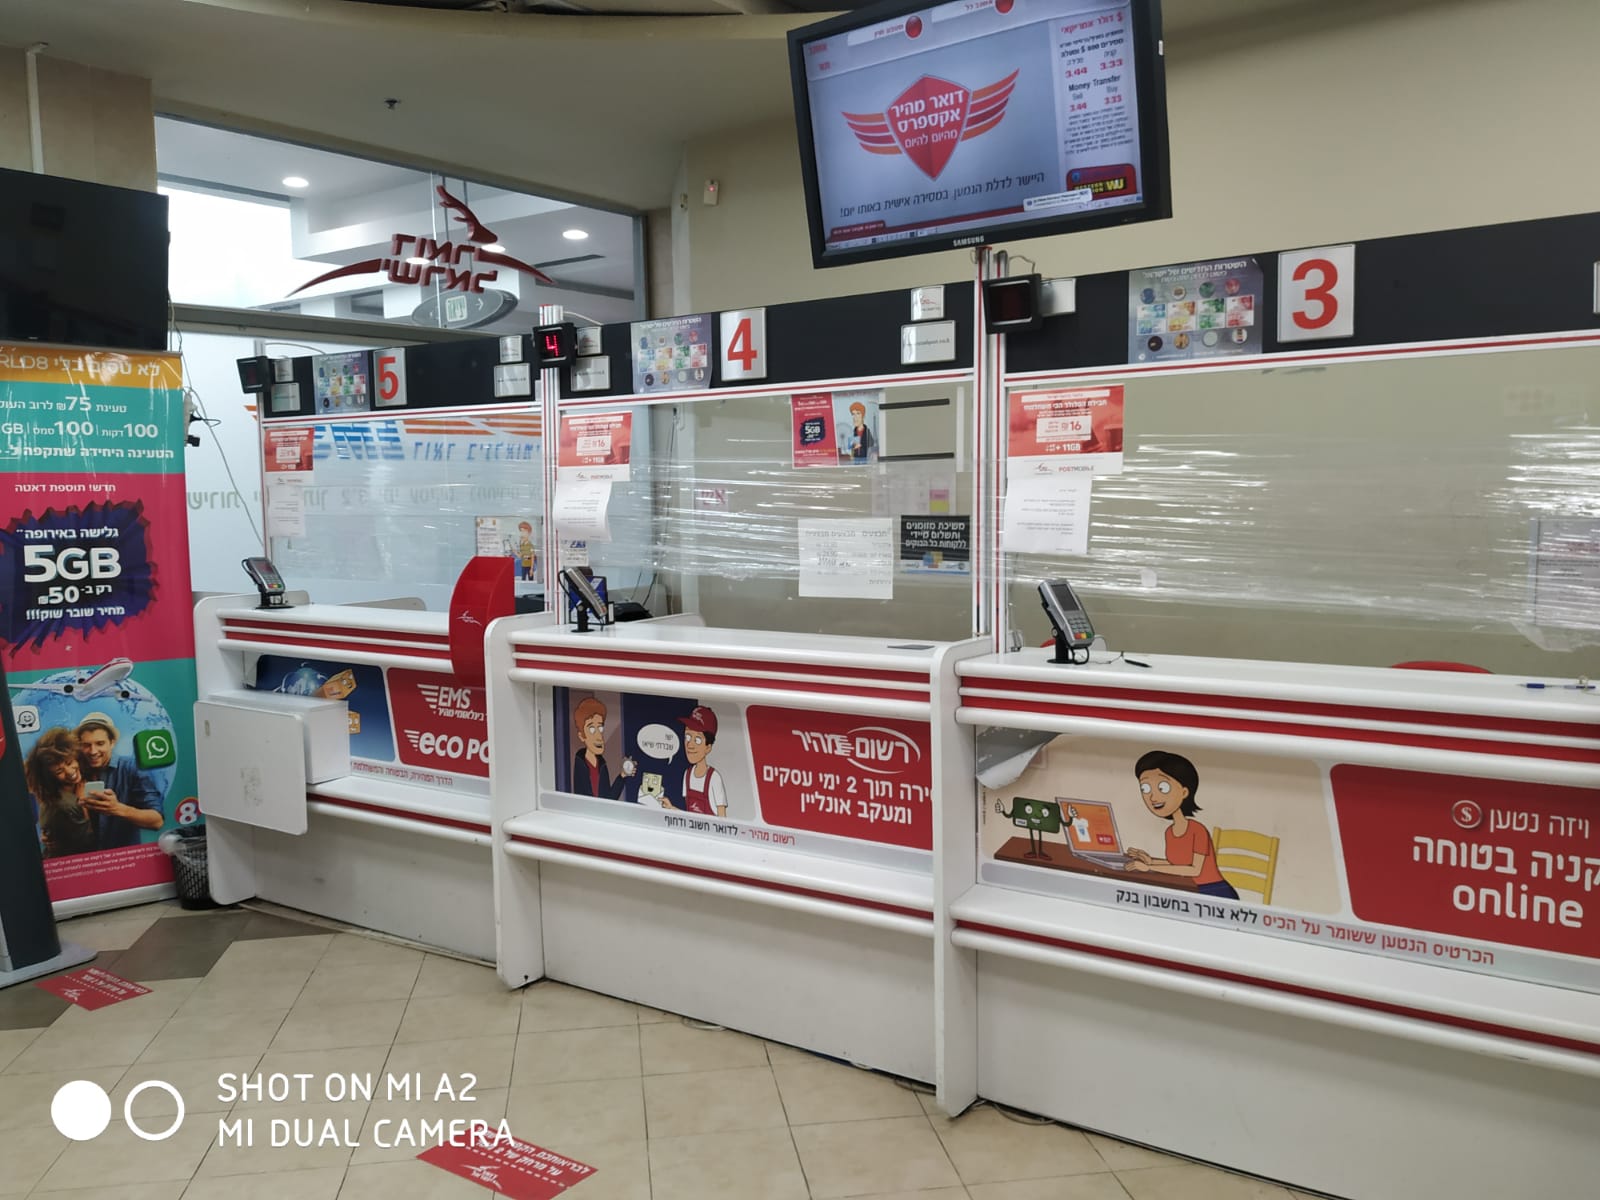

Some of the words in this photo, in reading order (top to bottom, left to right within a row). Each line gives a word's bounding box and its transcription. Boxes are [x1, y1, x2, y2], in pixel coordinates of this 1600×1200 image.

[1068, 82, 1091, 92] Money
[1092, 74, 1121, 87] Transfer
[929, 89, 964, 109] דואר
[891, 99, 926, 118] מהיר
[897, 108, 961, 133] אקספרס
[904, 134, 929, 148] להיום
[931, 129, 959, 143] מהיום
[985, 174, 1012, 193] לדלת
[1014, 170, 1045, 187] היישר
[1106, 179, 1124, 191] WU
[912, 188, 949, 206] במסירה
[953, 183, 983, 201] הנמען
[839, 205, 855, 218] יום!
[857, 202, 881, 216] באותו
[883, 196, 911, 210] אישית
[953, 236, 985, 247] SAMSUNG
[1292, 259, 1338, 329] 3
[546, 335, 558, 357] 4
[727, 318, 757, 370] 4
[378, 357, 399, 401] 5
[28, 400, 54, 410] לרוב
[96, 404, 127, 413] טעינת
[54, 421, 94, 436] 100
[102, 429, 123, 438] דקות
[124, 423, 158, 438] 100
[24, 446, 76, 458] שתקפה
[80, 447, 124, 458] היחידה
[128, 449, 174, 459] הטעינה
[15, 484, 46, 492] דאטה
[50, 484, 86, 492] תוספת
[89, 484, 116, 492] חדש!
[80, 526, 119, 538] גלישה
[906, 522, 937, 530] מזומנים
[938, 522, 965, 530] משיכת
[931, 531, 960, 541] ותשלום
[23, 544, 122, 583] 5GB
[96, 584, 112, 595] רק
[26, 609, 63, 621] שוק!!!
[66, 607, 94, 618] שובר
[97, 605, 125, 616] מחיר
[438, 686, 472, 710] EMS
[437, 707, 454, 718] מהיר
[791, 729, 852, 756] מהיר
[855, 737, 910, 764] רשום
[762, 765, 813, 787] עסקים
[818, 771, 840, 790] ימי
[846, 775, 857, 793] 2
[863, 778, 893, 800] תוך
[899, 782, 932, 803] ירה
[800, 790, 851, 815] אונליין
[179, 802, 198, 825] 8
[664, 815, 687, 827] ודחוף
[857, 801, 912, 825] ומעקב
[1489, 808, 1539, 833] נטען
[688, 819, 710, 832] חשוב
[712, 823, 738, 836] לדואר
[1549, 815, 1590, 839] ויזה
[748, 828, 770, 841] מהיר
[772, 832, 796, 846] רשום
[1412, 835, 1518, 875] בטוחה
[1115, 889, 1140, 905] בנק
[1143, 896, 1190, 914] בחשבון
[1452, 882, 1584, 928] online
[1192, 903, 1226, 923] צורך
[1230, 910, 1258, 924] ללא
[1262, 913, 1297, 931] הכיס
[1301, 919, 1321, 936] על
[1325, 924, 1377, 945] ששומר
[1381, 936, 1427, 957] הנטען
[1432, 946, 1495, 965] הכרטיס
